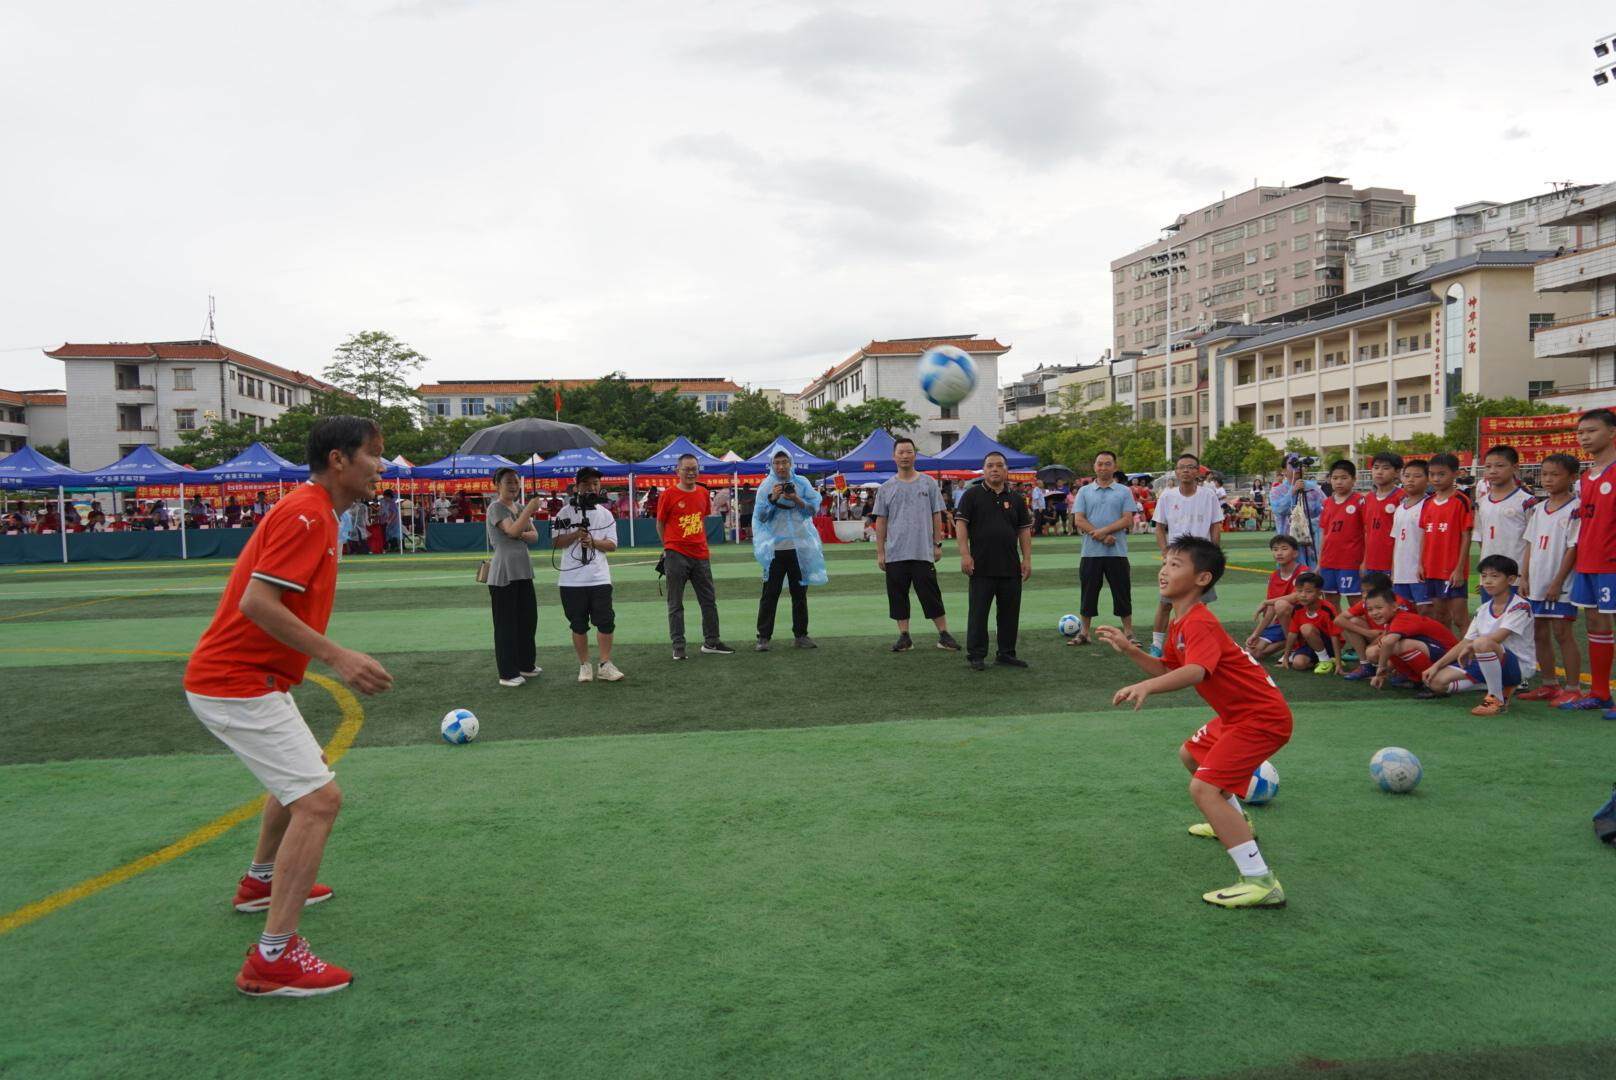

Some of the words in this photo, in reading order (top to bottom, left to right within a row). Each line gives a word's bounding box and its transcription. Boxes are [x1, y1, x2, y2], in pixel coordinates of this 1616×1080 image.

[1331, 520, 1344, 532] 27
[1401, 529, 1406, 541] 5
[1490, 526, 1495, 539] 1
[1539, 535, 1549, 550] 11
[1340, 576, 1353, 588] 27
